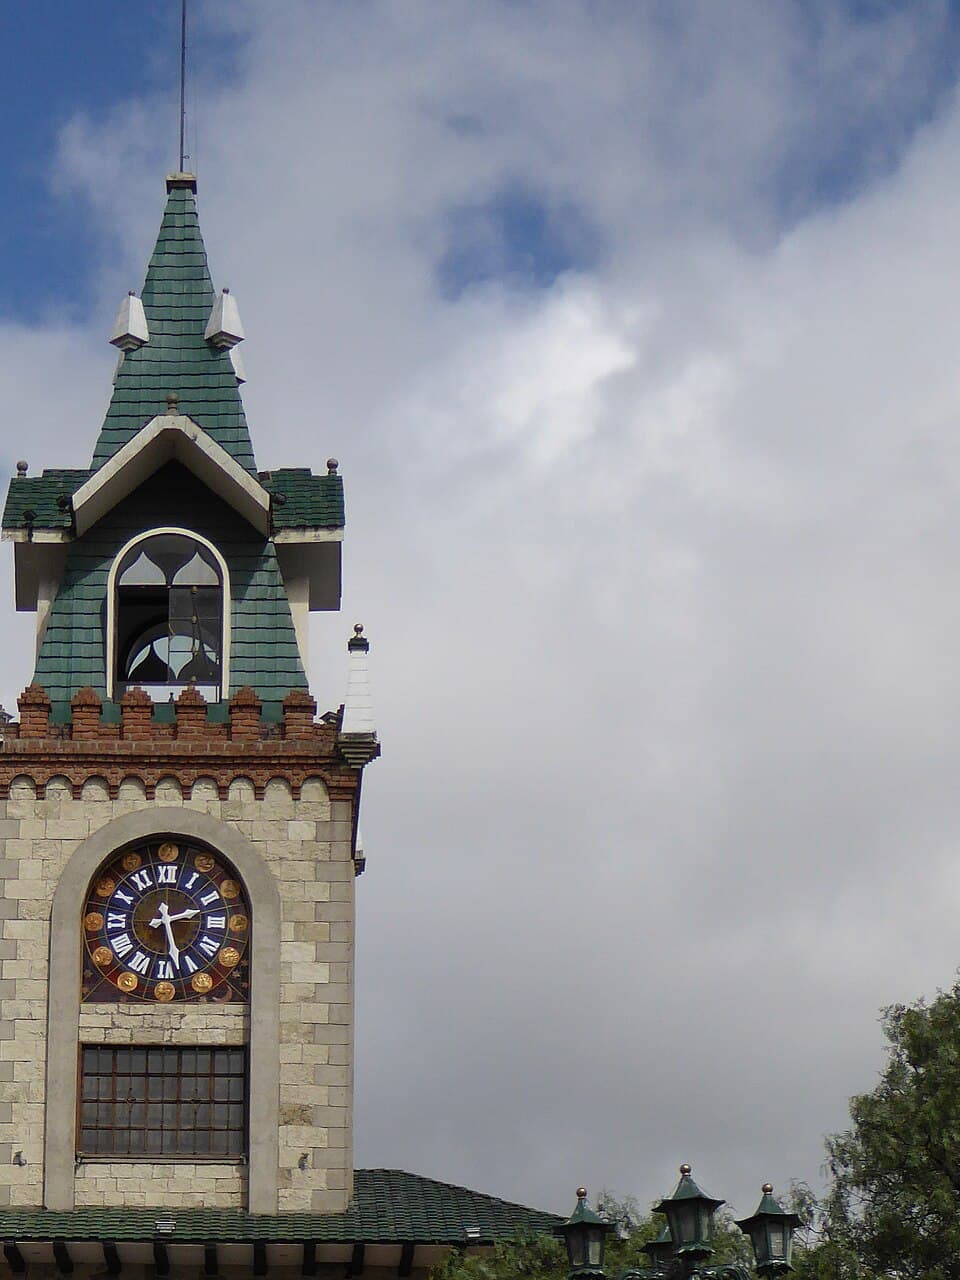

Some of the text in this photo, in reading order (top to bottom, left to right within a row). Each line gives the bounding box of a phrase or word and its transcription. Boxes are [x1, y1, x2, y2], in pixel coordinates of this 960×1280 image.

[131, 869, 153, 891] XI
[158, 865, 178, 883] XII
[185, 872, 199, 889] I
[114, 890, 134, 905] X
[201, 890, 220, 906] II
[107, 912, 127, 929] IX
[207, 916, 226, 929] III
[110, 933, 134, 958] VIII
[199, 936, 221, 957] IV
[128, 951, 151, 975] VII
[157, 961, 175, 979] VI
[185, 955, 199, 973] V
